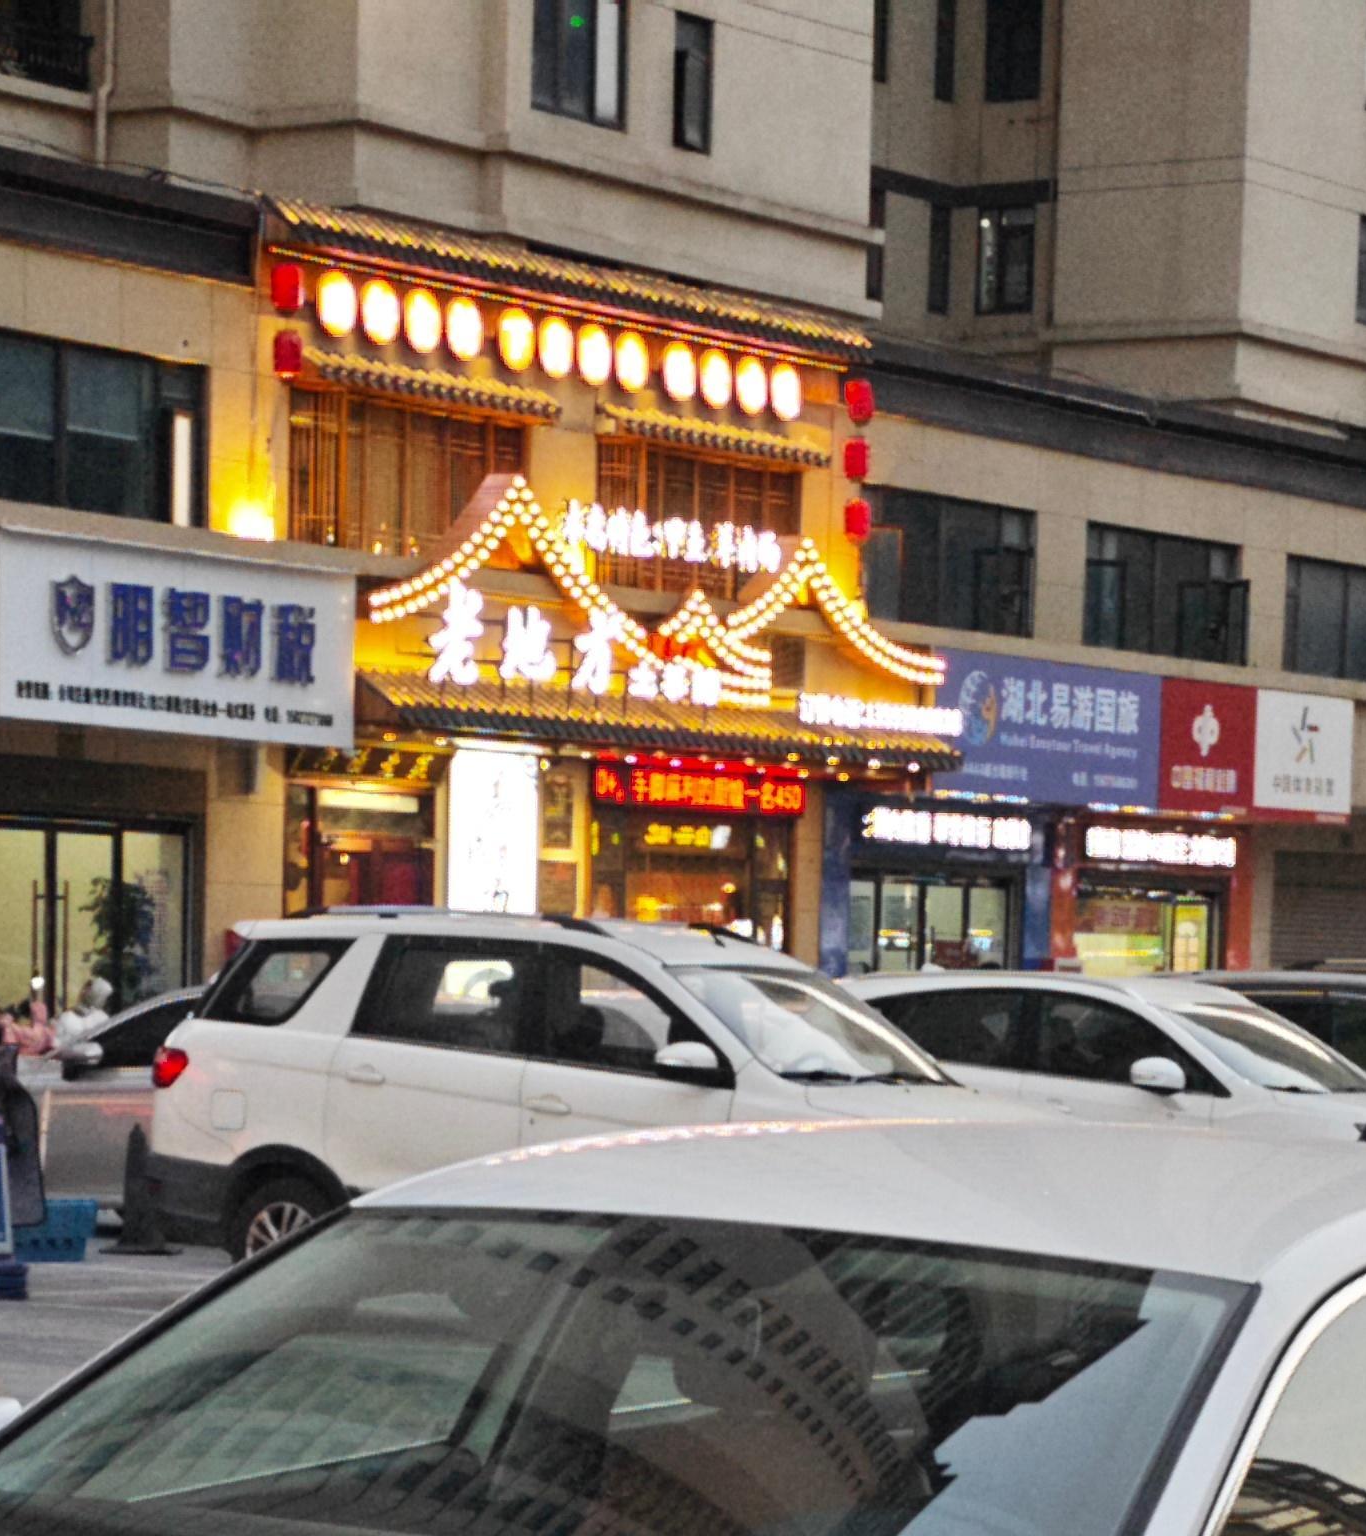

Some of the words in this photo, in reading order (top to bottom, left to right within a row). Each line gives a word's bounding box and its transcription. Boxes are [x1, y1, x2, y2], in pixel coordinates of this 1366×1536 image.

[107, 582, 315, 685] 明智财税
[428, 577, 625, 695] 老地方
[1001, 676, 1139, 735] 湖北易游国旅
